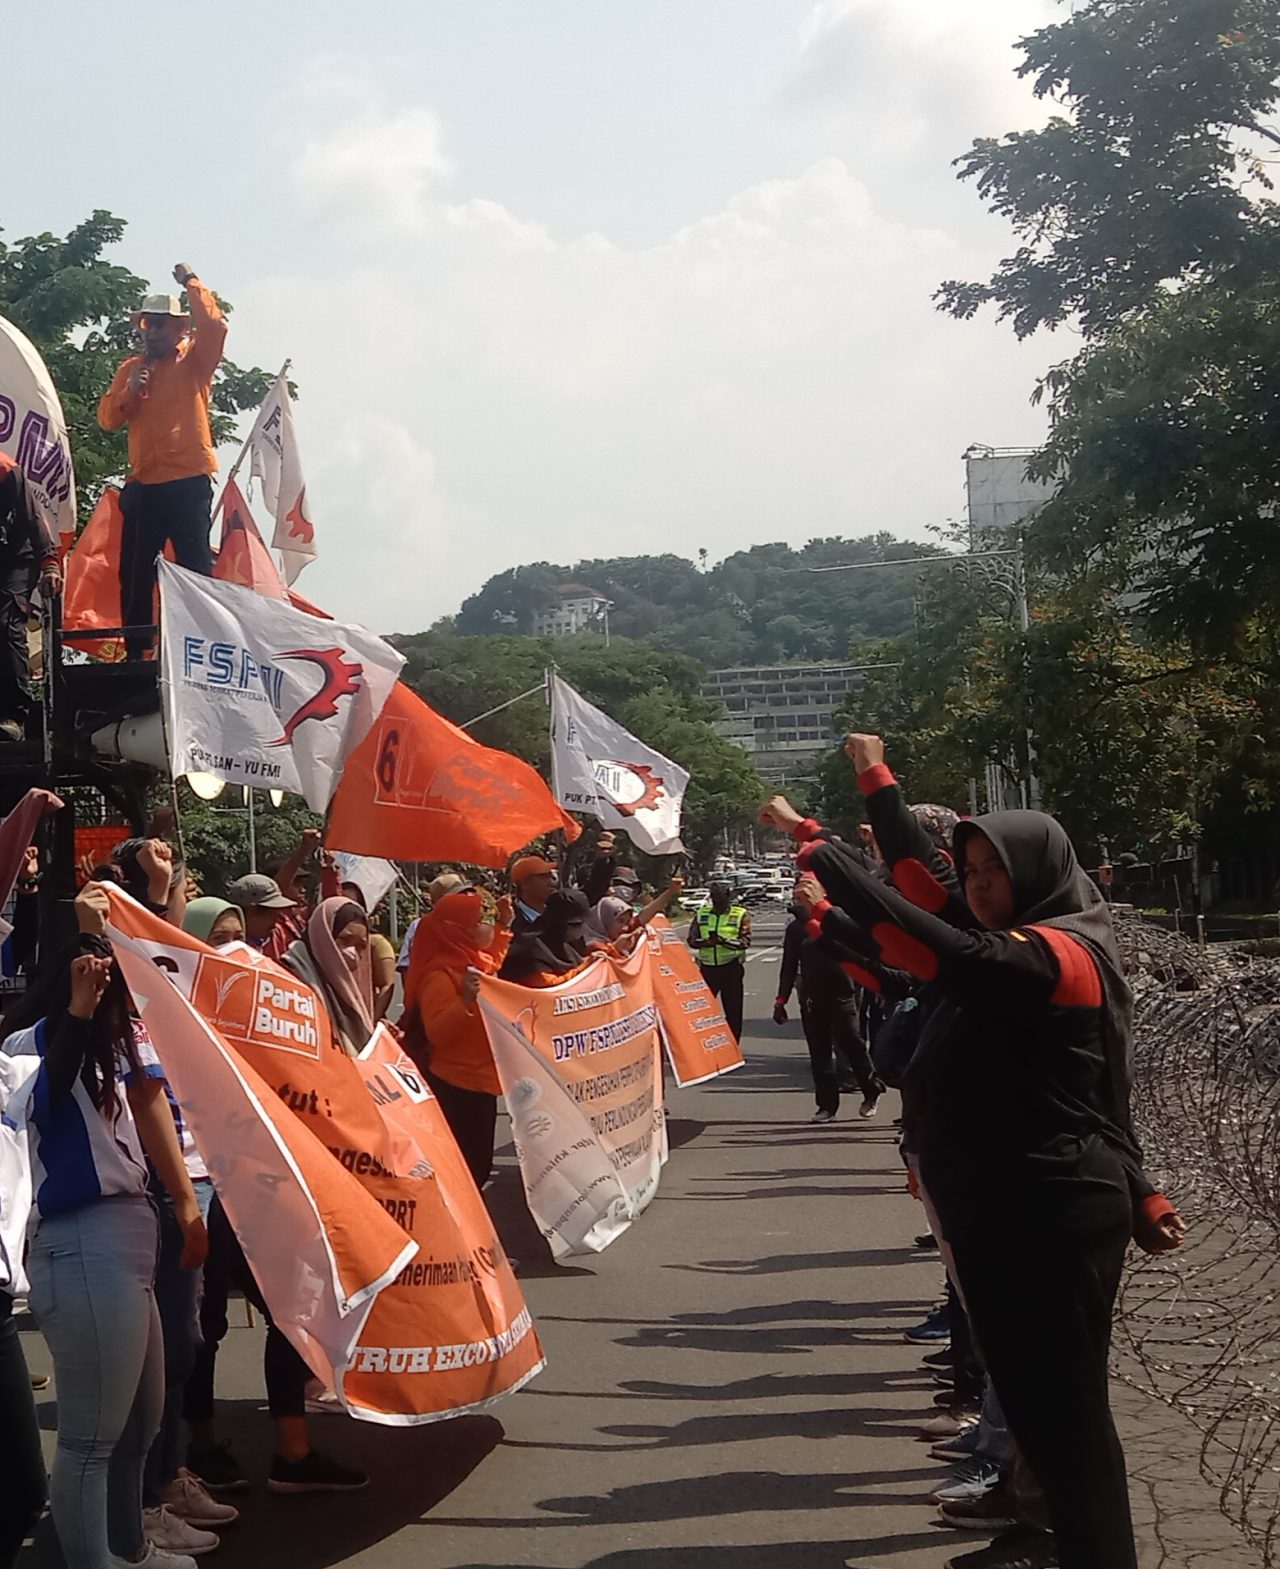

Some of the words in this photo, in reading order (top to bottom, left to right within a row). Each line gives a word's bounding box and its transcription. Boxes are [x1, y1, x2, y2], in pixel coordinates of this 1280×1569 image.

[380, 729, 400, 793] 6
[564, 792, 583, 804] PUK
[258, 978, 317, 1020] Partai
[255, 1005, 317, 1048] Buruh
[552, 1034, 586, 1062] DPW
